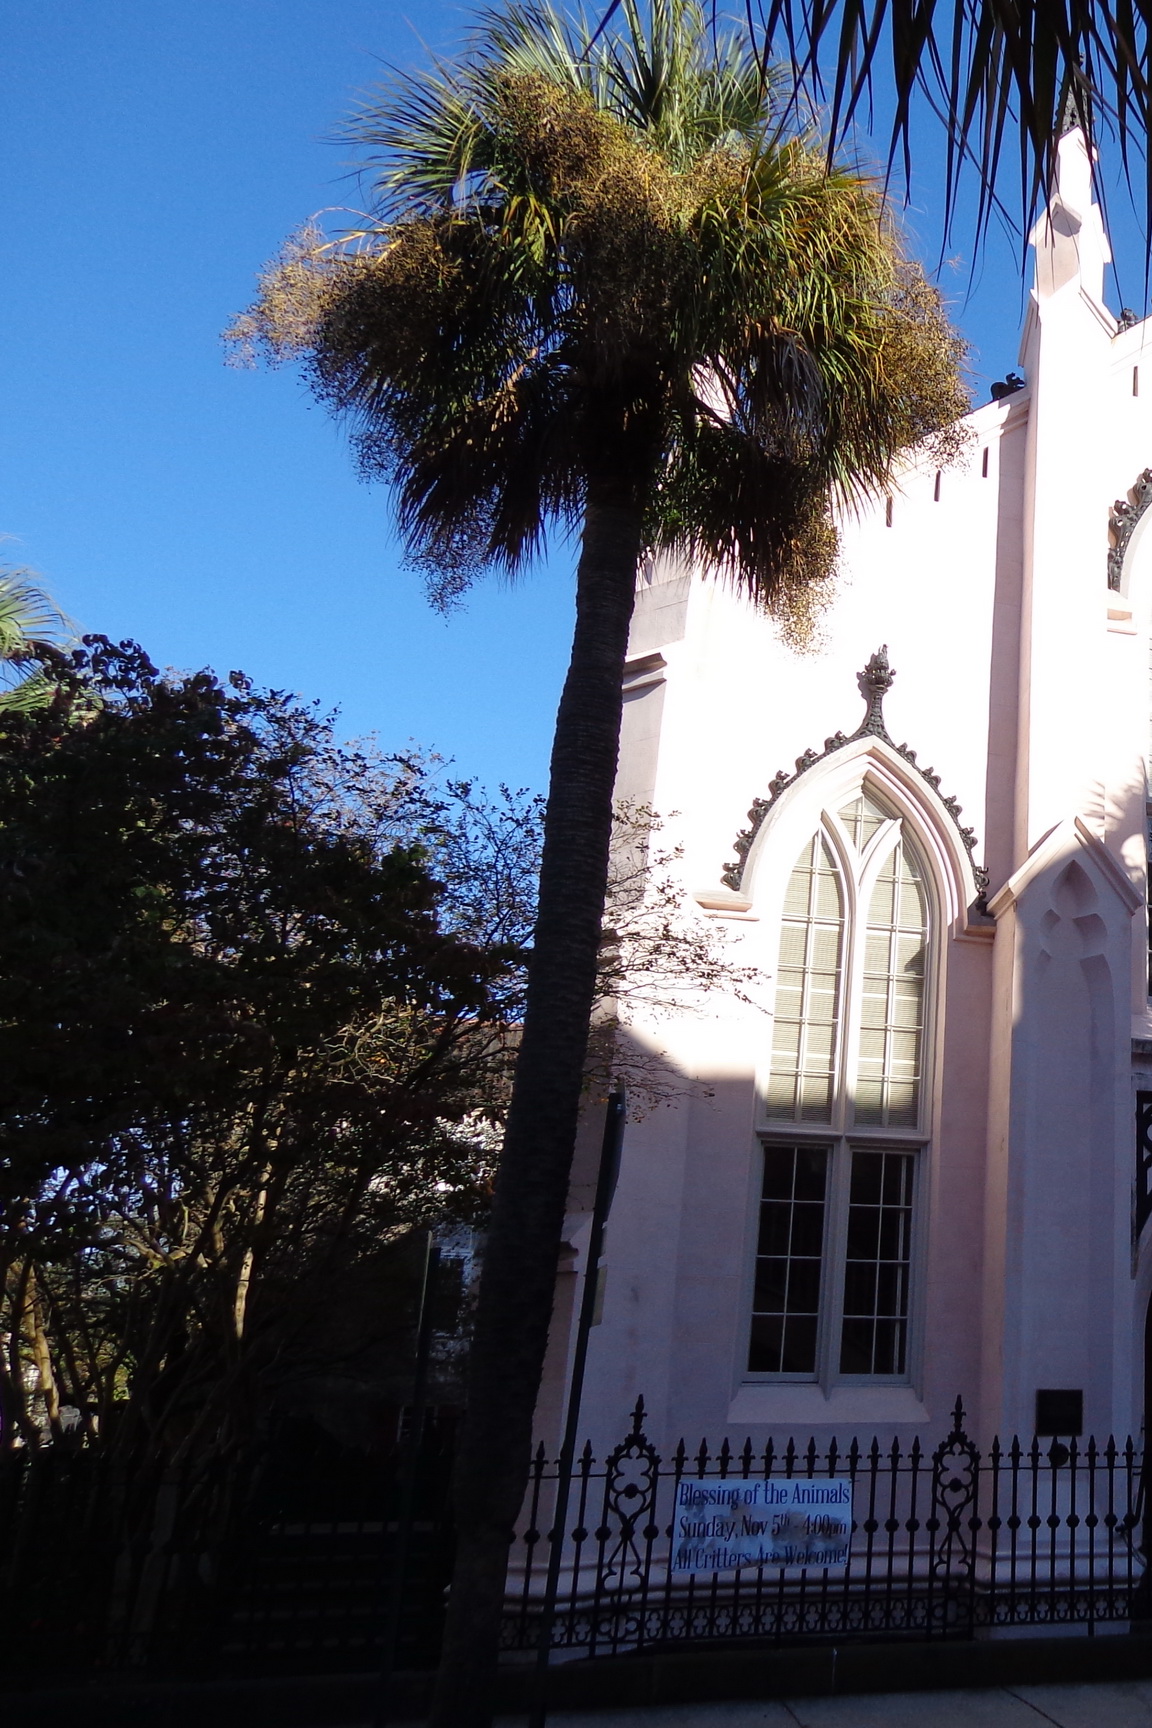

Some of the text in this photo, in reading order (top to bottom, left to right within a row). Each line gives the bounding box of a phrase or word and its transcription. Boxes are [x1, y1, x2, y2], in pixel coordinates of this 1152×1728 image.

[679, 1481, 850, 1510] Blessing of the Animals
[679, 1516, 738, 1542] Sunday,
[741, 1515, 768, 1537] Nov
[771, 1513, 790, 1536] 5th
[802, 1514, 847, 1537] 4:00pm
[673, 1543, 849, 1569] All Critters Are Welcome!
